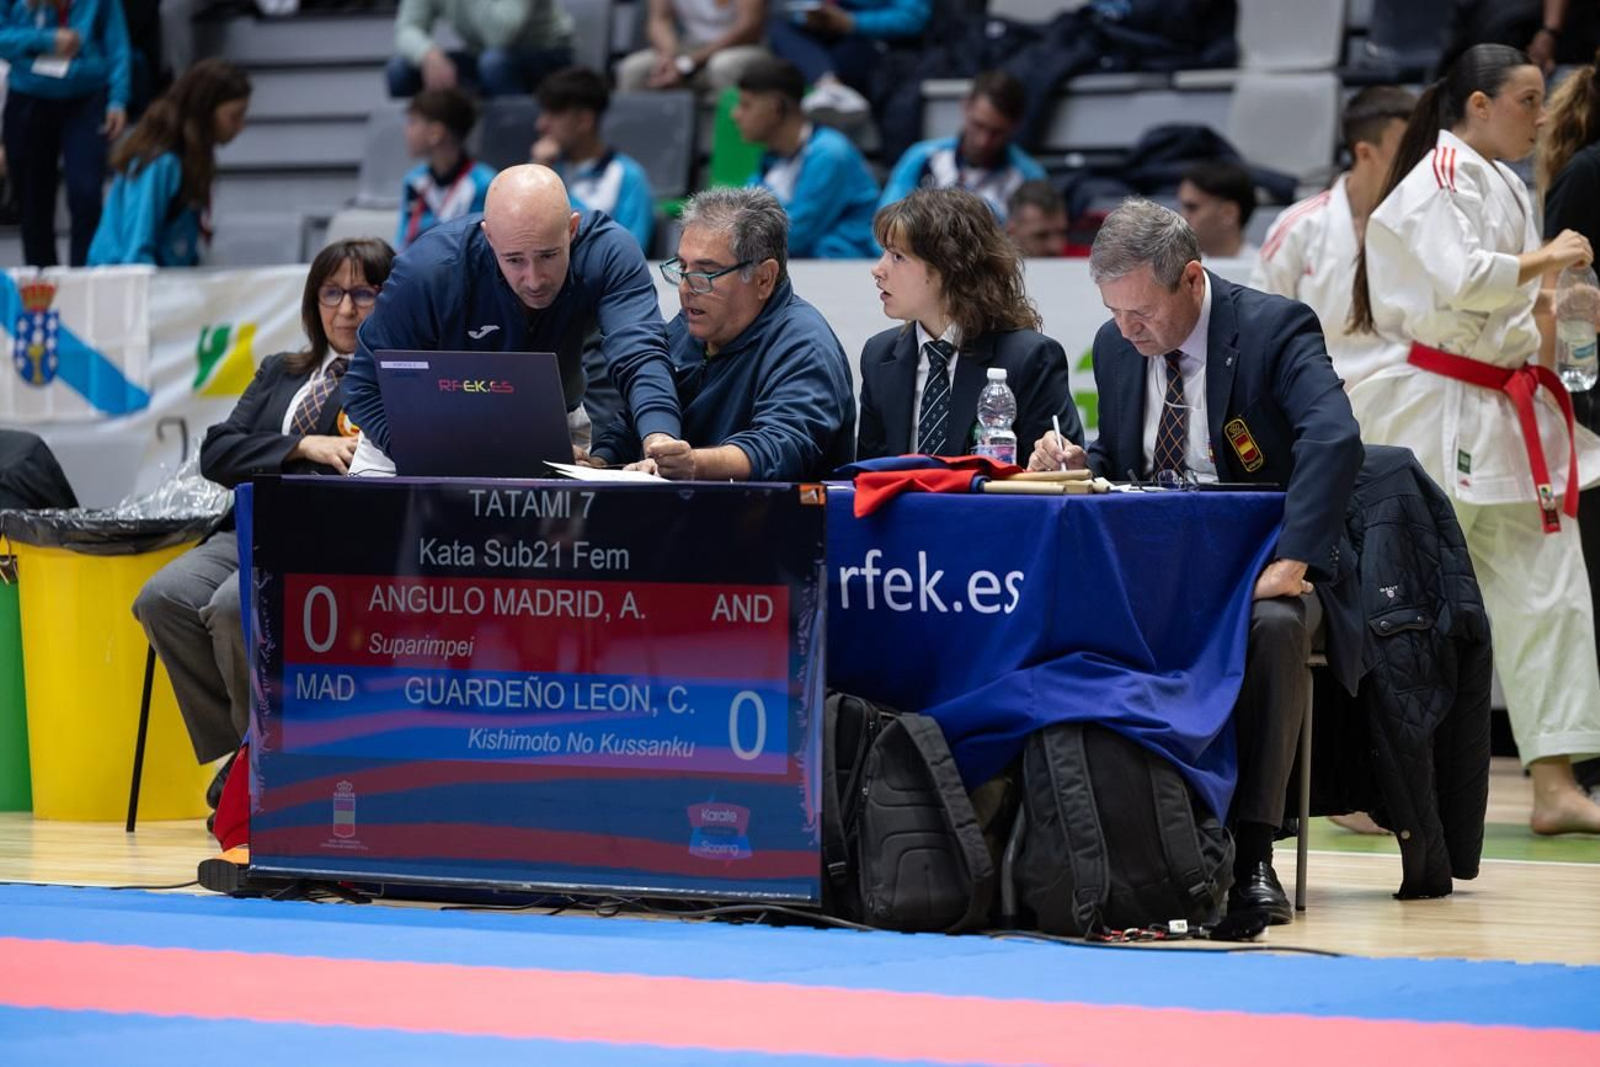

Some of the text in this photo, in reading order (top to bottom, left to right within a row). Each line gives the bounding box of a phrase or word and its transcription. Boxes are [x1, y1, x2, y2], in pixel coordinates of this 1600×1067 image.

[469, 489, 595, 519] TATAMI 7
[420, 538, 629, 570] Kata Sub21 Fem
[839, 549, 1024, 614] rfek.es
[303, 585, 338, 653] 0
[369, 584, 646, 623] ANGULO MADRID, A.
[711, 594, 773, 623] AND
[369, 632, 474, 659] Suparimpei
[296, 673, 355, 701] MAD
[405, 675, 696, 716] GUARDEÑO LEON, C.
[728, 690, 767, 760] 0
[467, 727, 695, 759] Kishimoto No Kussanku
[701, 808, 737, 823] Karate
[701, 840, 739, 857] Scoring
